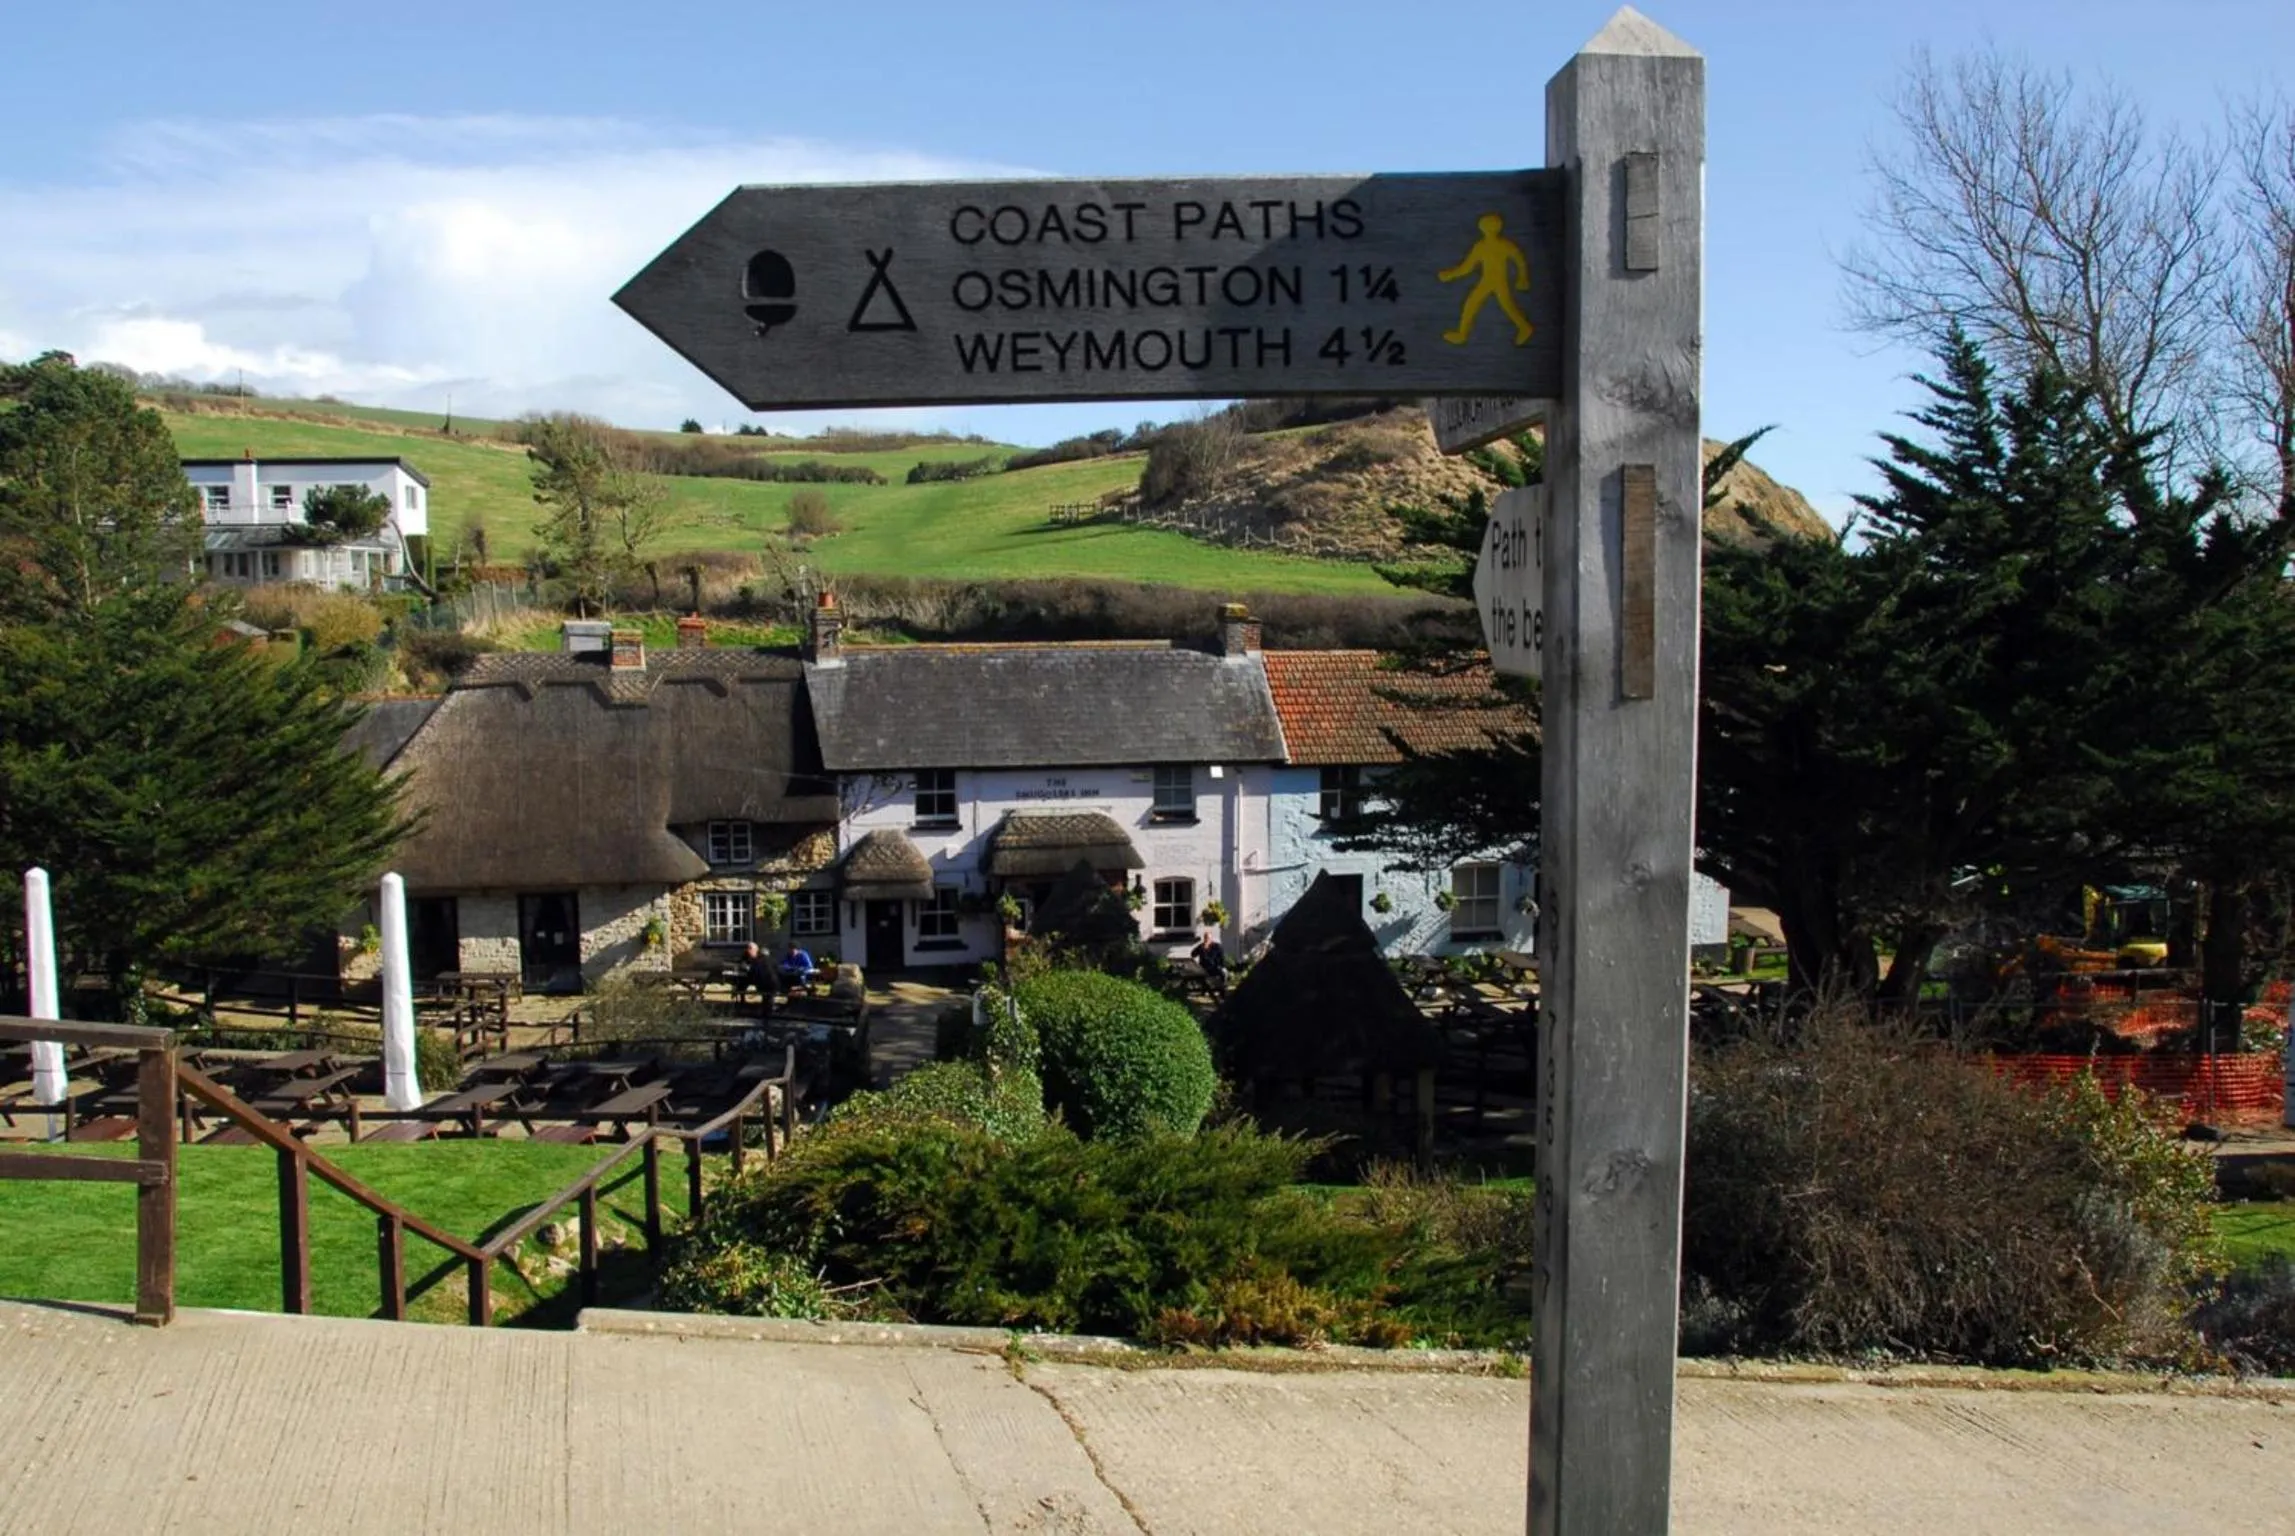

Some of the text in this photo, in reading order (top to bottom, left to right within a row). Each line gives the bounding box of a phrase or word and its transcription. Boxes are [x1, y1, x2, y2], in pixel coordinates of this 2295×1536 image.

[951, 201, 1364, 245] COAST PATHS
[952, 266, 1302, 311] OSMINGTON
[956, 329, 1292, 372] WEYMOUTH
[1491, 516, 1542, 570] Path t
[1492, 597, 1543, 650] the be
